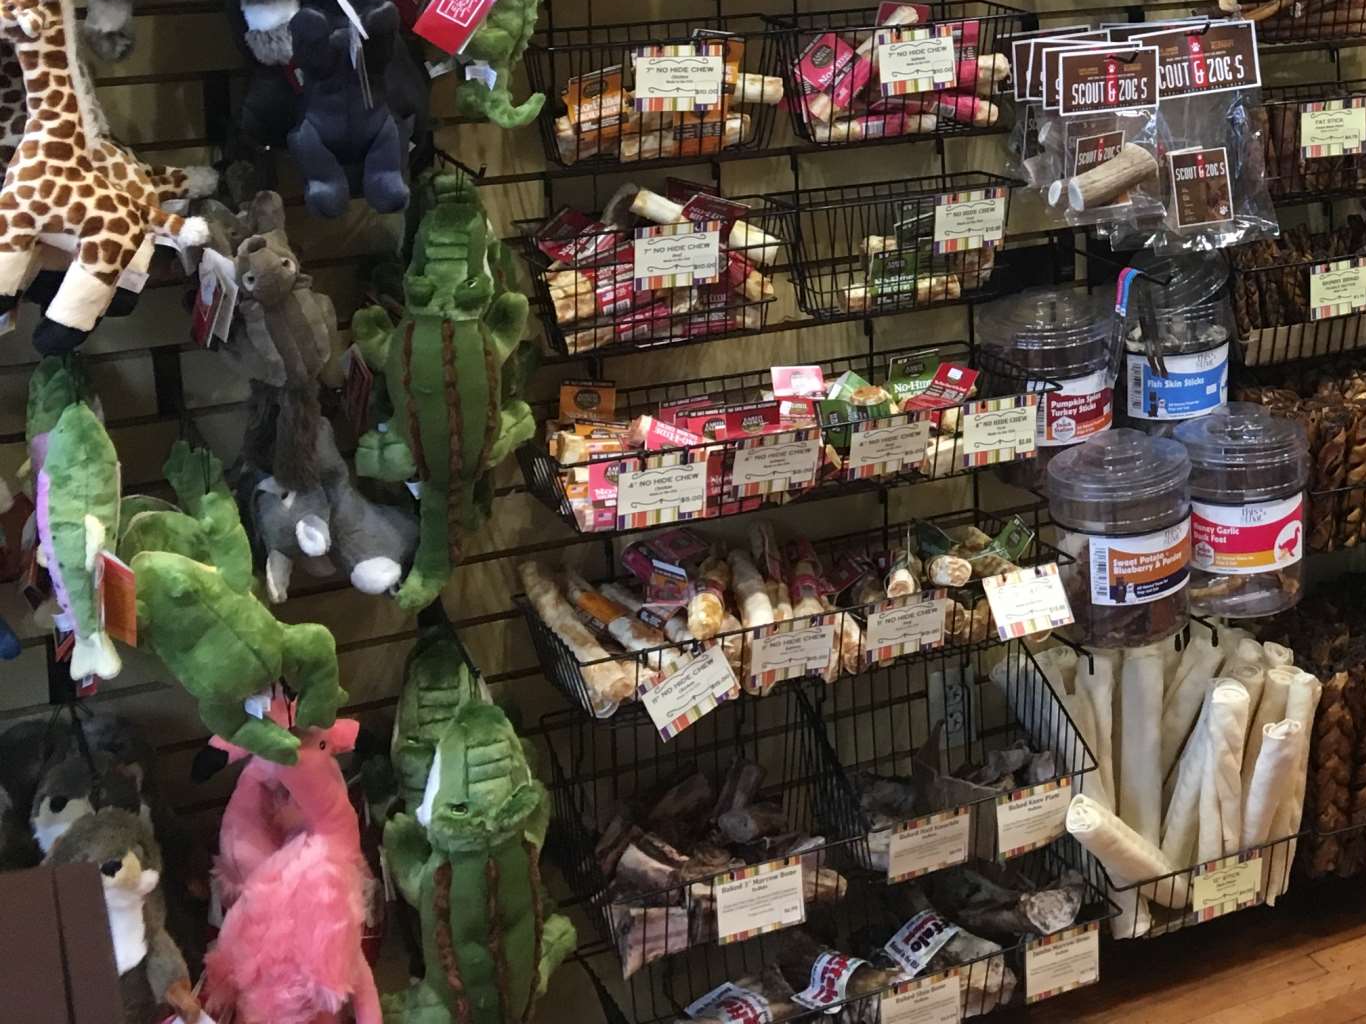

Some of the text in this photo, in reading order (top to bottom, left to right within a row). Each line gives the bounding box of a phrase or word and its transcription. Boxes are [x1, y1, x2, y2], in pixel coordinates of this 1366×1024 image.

[1158, 62, 1189, 90] COUT
[1072, 81, 1104, 105] SCOUT
[1078, 150, 1096, 166] SCOUT
[1176, 167, 1197, 180] SCOUT
[1147, 377, 1204, 388] Fish Skin Sticks
[1051, 397, 1085, 409] Pumpkin
[1051, 403, 1097, 417] Turkey Sticks
[675, 473, 699, 482] CHEW
[1216, 526, 1240, 535] Garlic
[1113, 558, 1136, 568] Sweet
[1113, 563, 1154, 575] Blueberry
[898, 612, 916, 621] HIDE
[916, 607, 938, 617] CHEW
[803, 634, 827, 643] CHEW
[662, 659, 715, 698] NO HIDE CHEW
